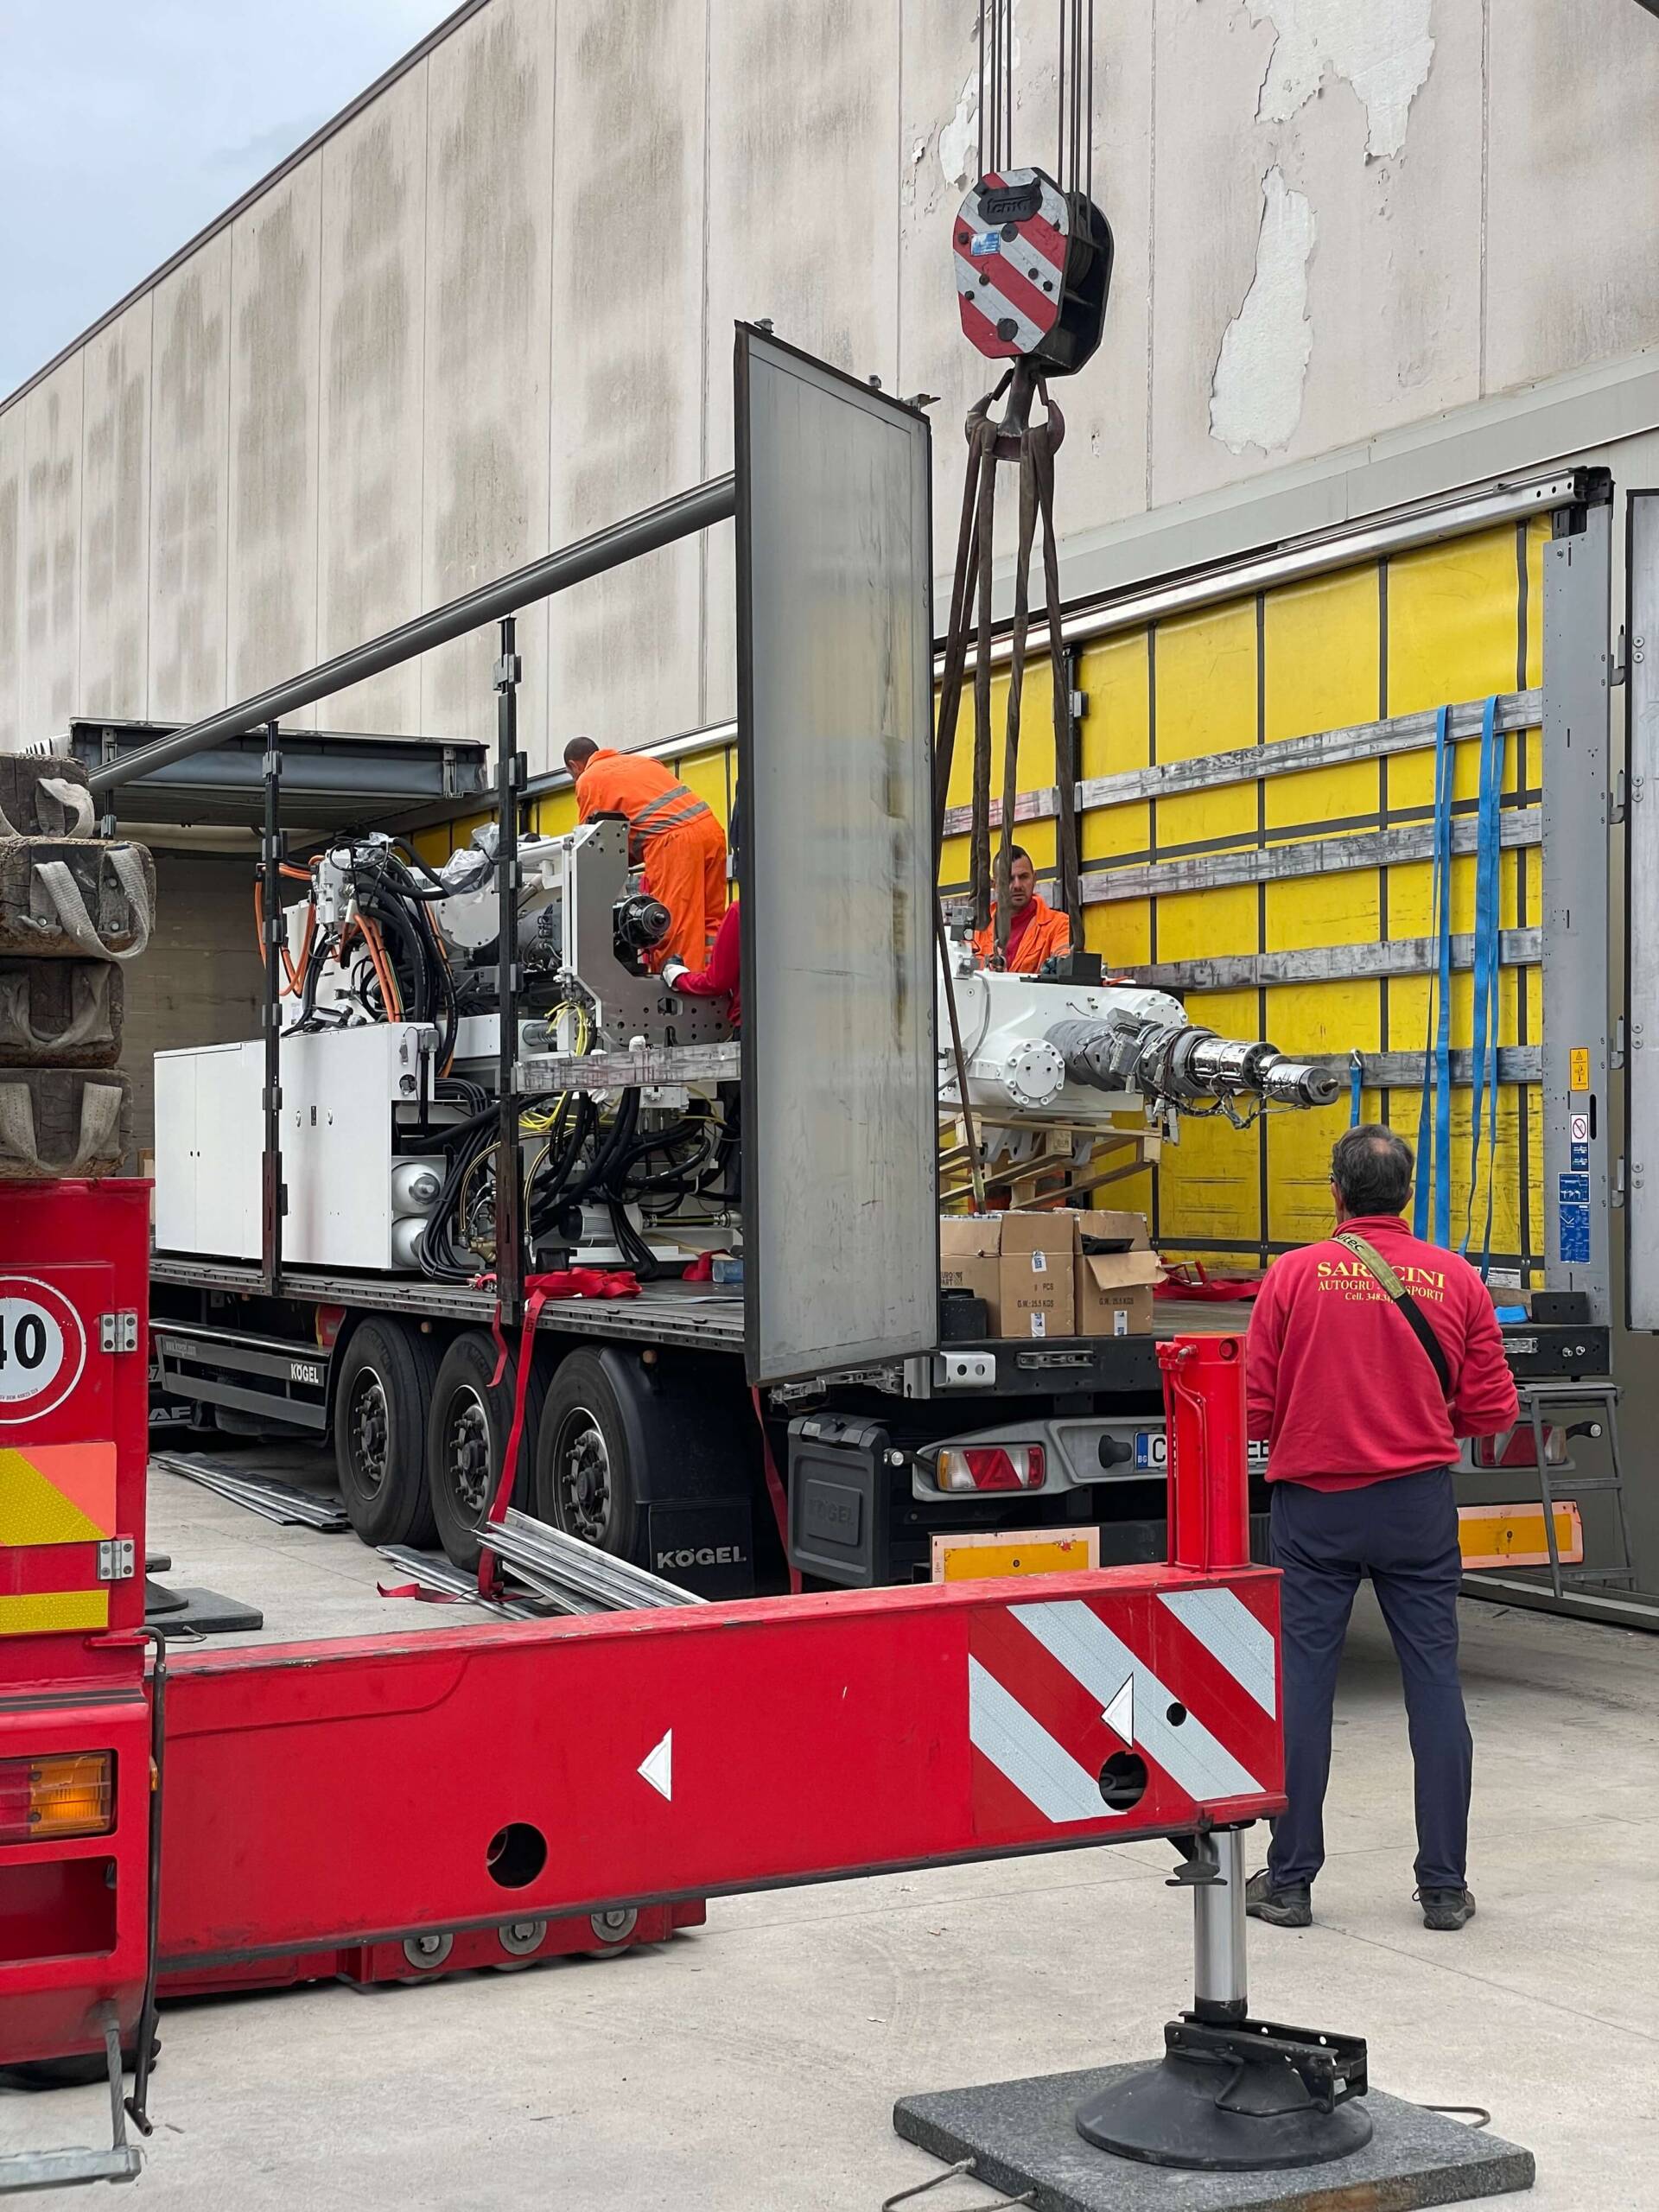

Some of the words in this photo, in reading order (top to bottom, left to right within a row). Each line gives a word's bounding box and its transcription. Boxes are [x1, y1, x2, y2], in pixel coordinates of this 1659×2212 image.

[1337, 1234, 1365, 1252] utec
[1317, 1261, 1446, 1290] SARCINI
[1318, 1279, 1375, 1292] AUTOGRU
[1405, 1285, 1444, 1303] SPORTI
[290, 1362, 319, 1384] KÖGEL
[148, 1405, 192, 1421] AF
[1137, 1454, 1147, 1464] BG
[657, 1545, 747, 1569] KÖGEL
